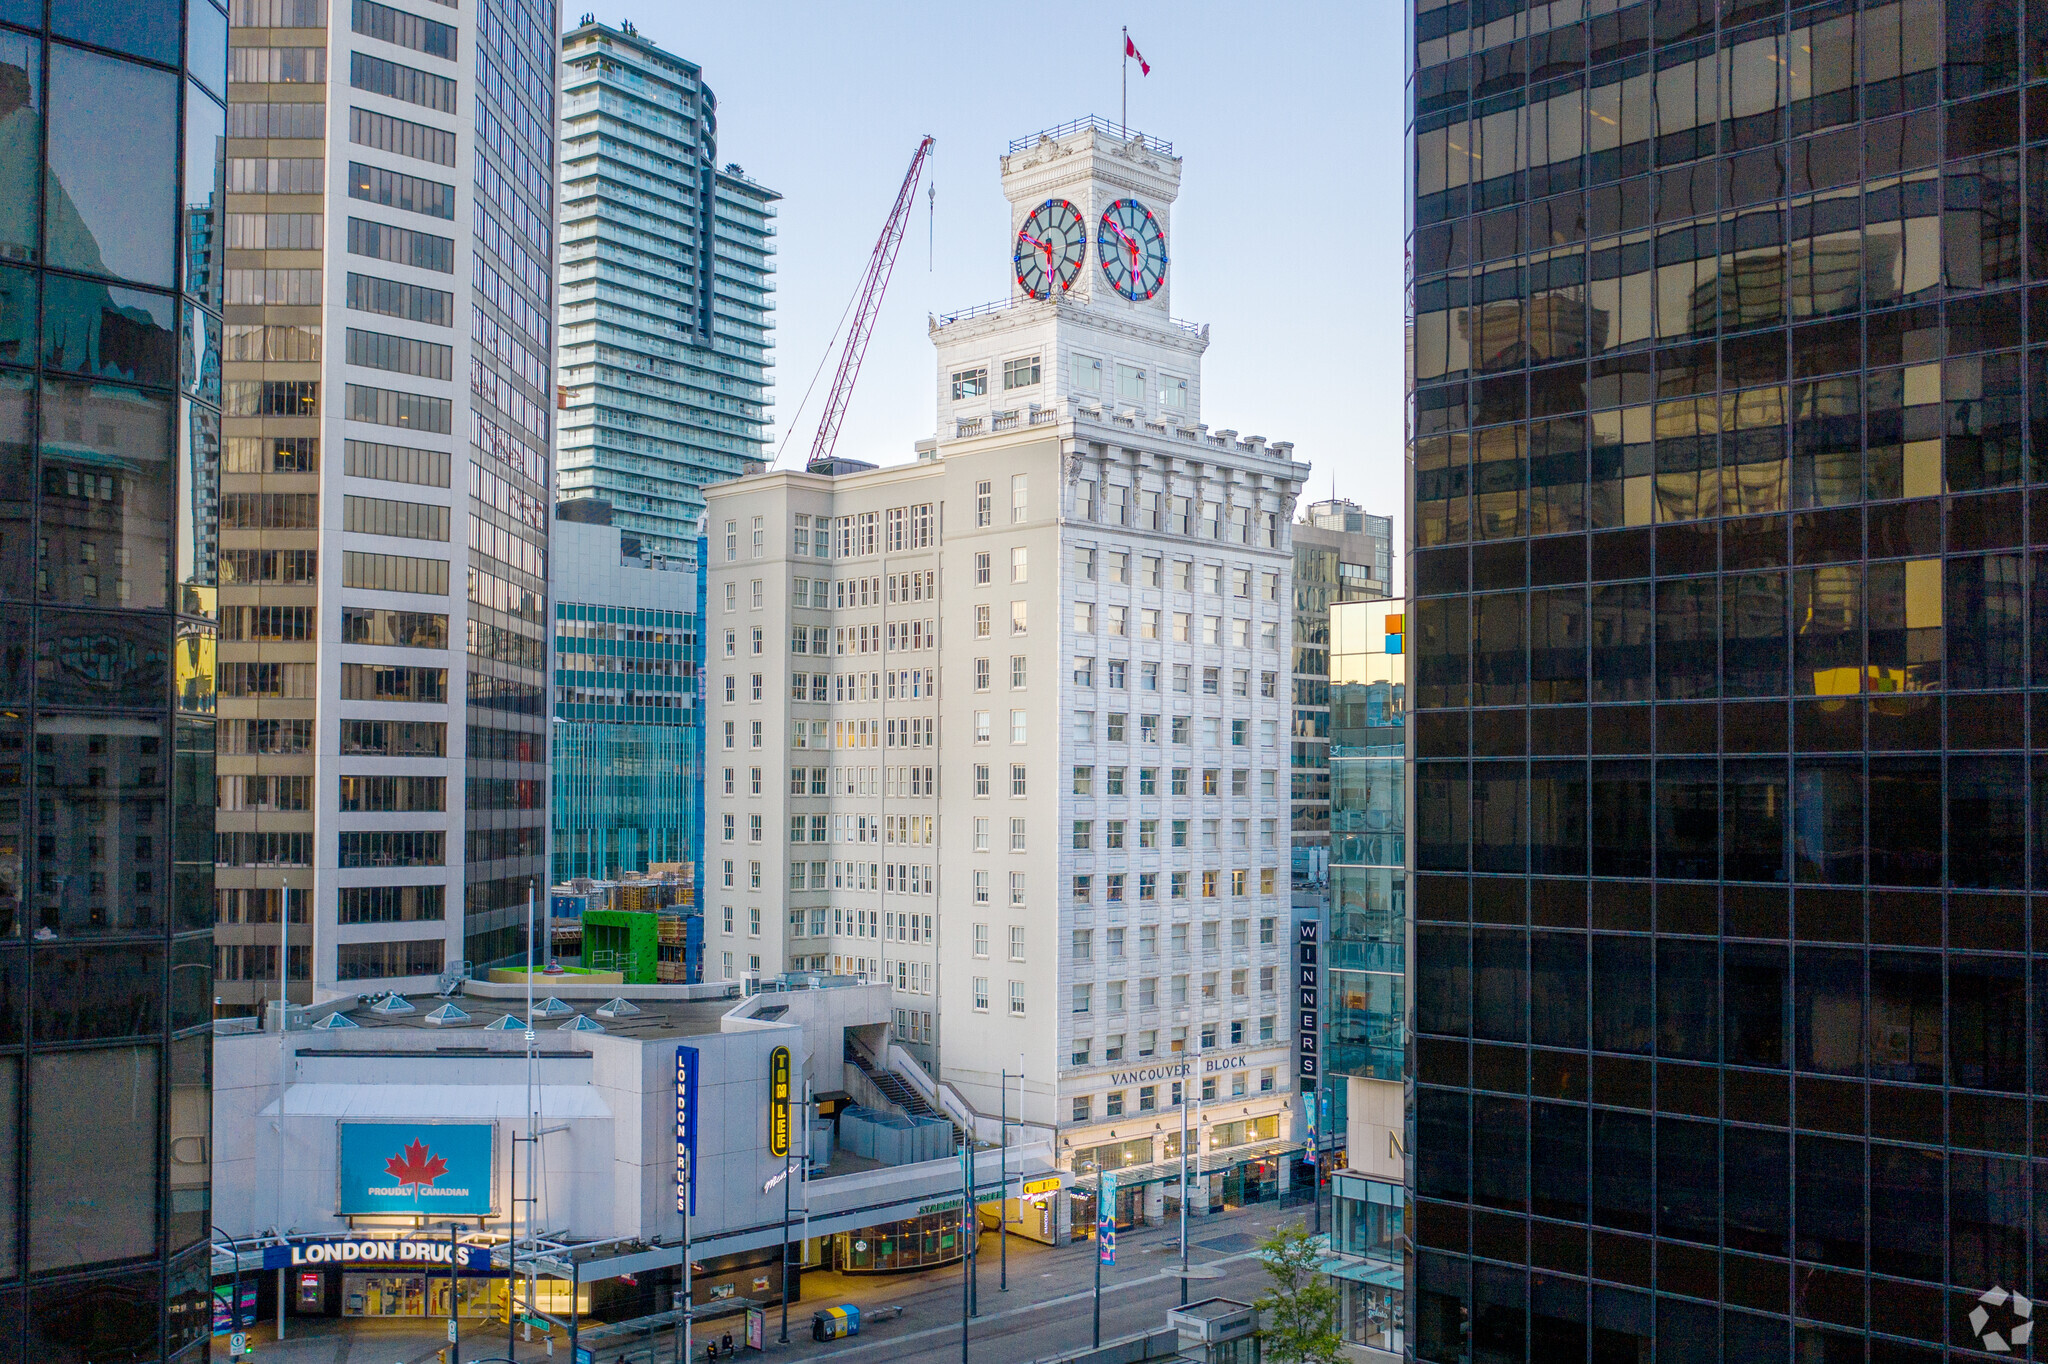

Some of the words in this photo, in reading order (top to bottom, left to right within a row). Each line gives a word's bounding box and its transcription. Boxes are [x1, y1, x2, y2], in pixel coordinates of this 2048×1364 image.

[1301, 926, 1315, 1073] WINNERS
[776, 1054, 787, 1099] TOM
[1111, 1063, 1190, 1085] VANCOUVER
[1206, 1055, 1246, 1072] BLOCK
[677, 1055, 686, 1137] LONDON
[776, 1104, 787, 1149] LEE
[368, 1187, 413, 1196] PROUDLY
[420, 1187, 469, 1197] CANADIAN
[677, 1143, 686, 1211] DRUGS
[763, 1163, 800, 1194] Musc
[291, 1242, 395, 1265] LONDON
